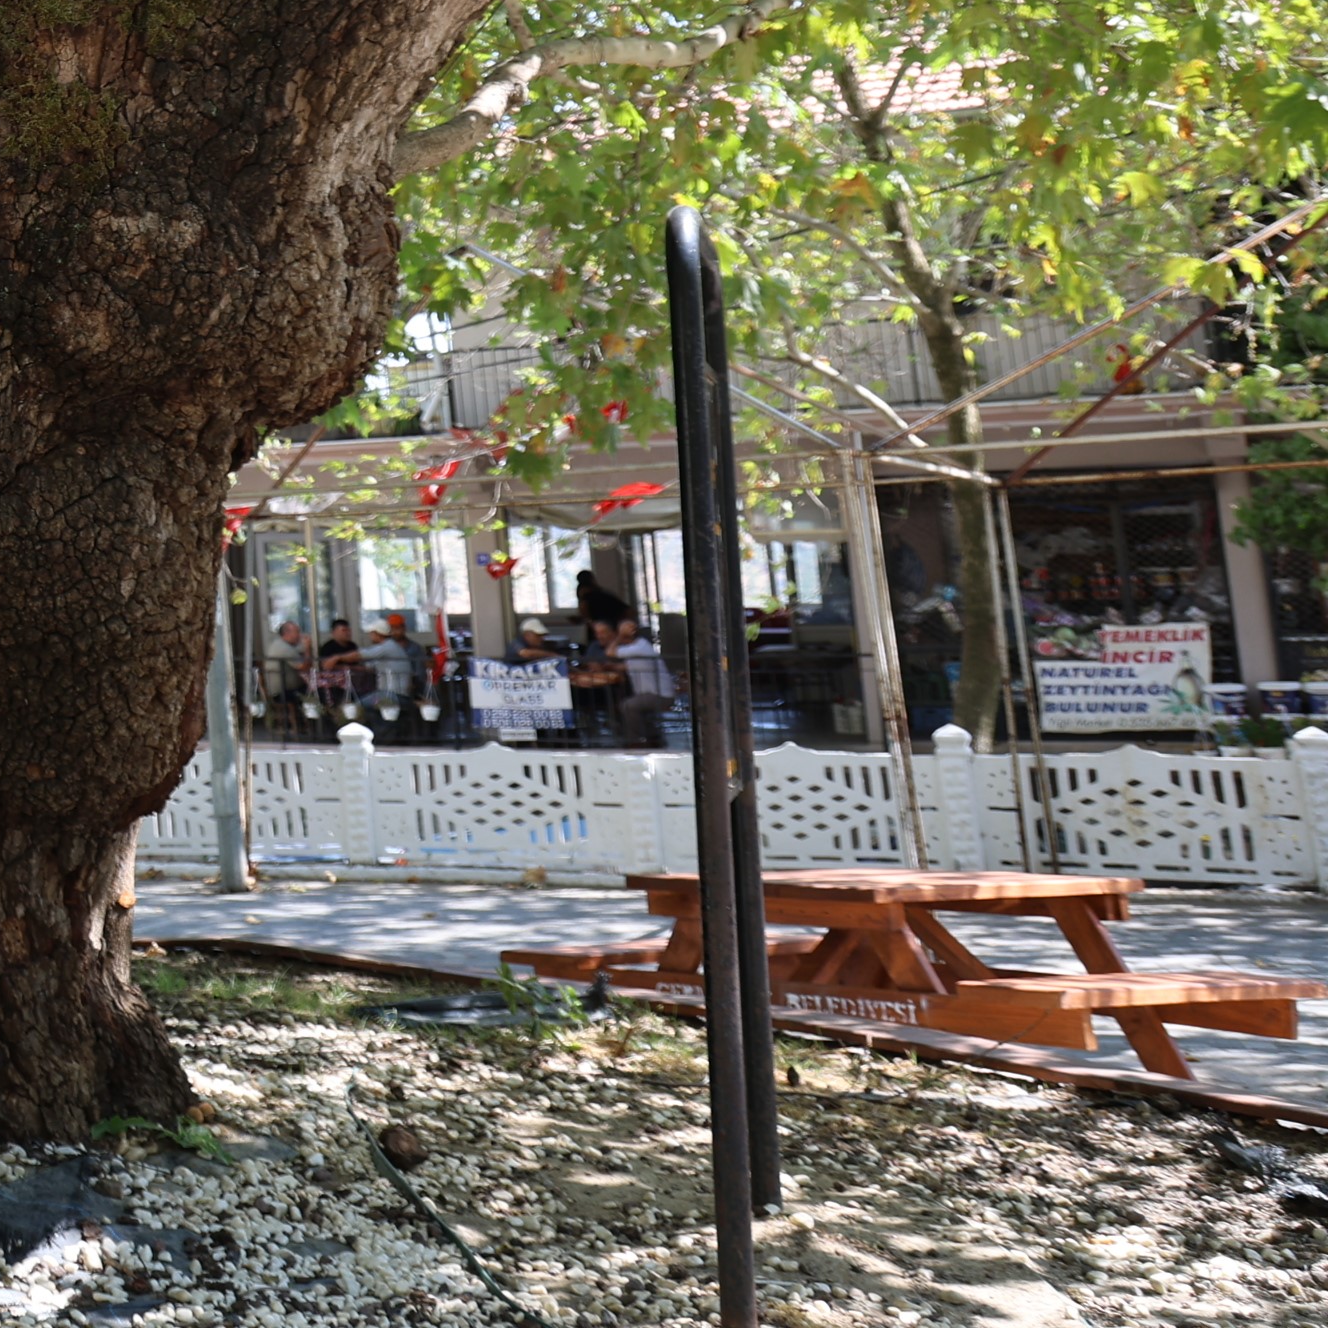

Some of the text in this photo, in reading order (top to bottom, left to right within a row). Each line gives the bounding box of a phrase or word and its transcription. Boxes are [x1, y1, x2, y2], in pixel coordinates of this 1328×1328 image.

[1099, 629, 1205, 644] YEMEKLİK
[1041, 667, 1137, 678] NATUREL
[1044, 701, 1149, 713] BULUNUR
